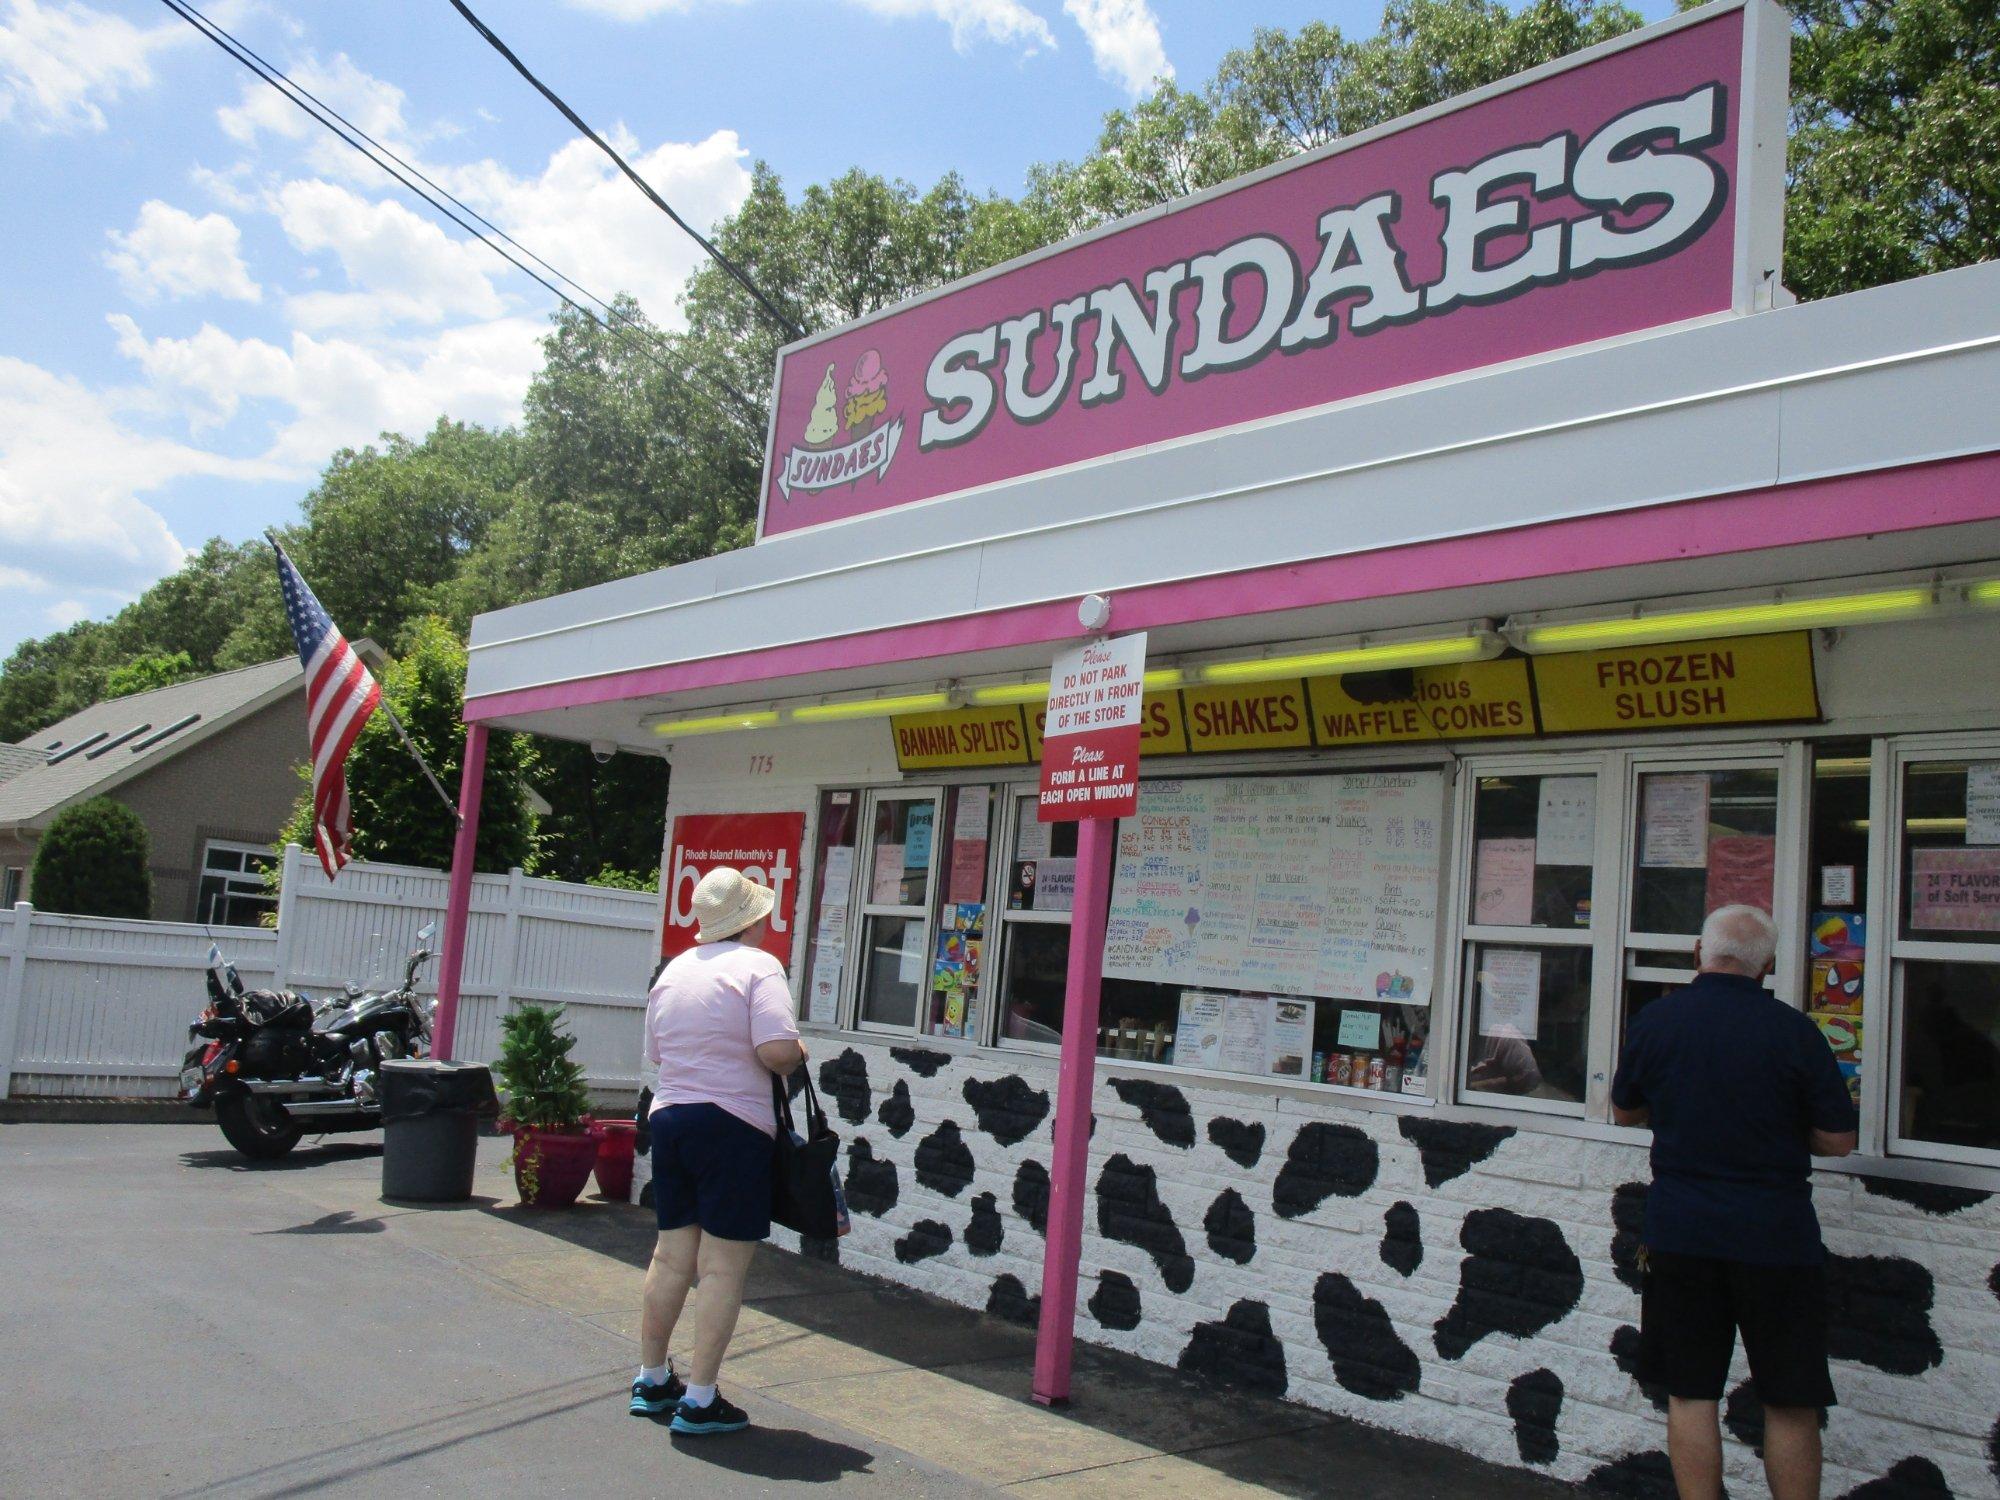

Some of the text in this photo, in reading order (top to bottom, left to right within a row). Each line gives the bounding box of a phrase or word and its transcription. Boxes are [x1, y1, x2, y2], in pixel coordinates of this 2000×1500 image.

[919, 83, 1727, 453] SUNDAES
[790, 432, 884, 484] SUNDAES
[1082, 650, 1112, 668] Please
[1596, 651, 1736, 690] FROZEN
[1064, 664, 1127, 689] DO NOT PARK
[1049, 682, 1140, 712] DIRECTLY IN FRONT
[1615, 687, 1727, 721] SLUSH
[1058, 704, 1126, 729] OF THE STORE
[1196, 694, 1299, 736] SHAKES
[1323, 701, 1524, 739] WAFFLE CONES
[899, 718, 1020, 758] BANANA SPLITS
[1071, 745, 1105, 765] Please
[1051, 764, 1125, 786] FORM A LINE AT
[1040, 782, 1135, 805] EACH OPEN WINDOW
[685, 849, 774, 863] Rhode Island Monthly's
[668, 844, 792, 933] bt
[1950, 873, 2000, 888] FLAVOR
[1928, 889, 2000, 904] of Soft Serv
